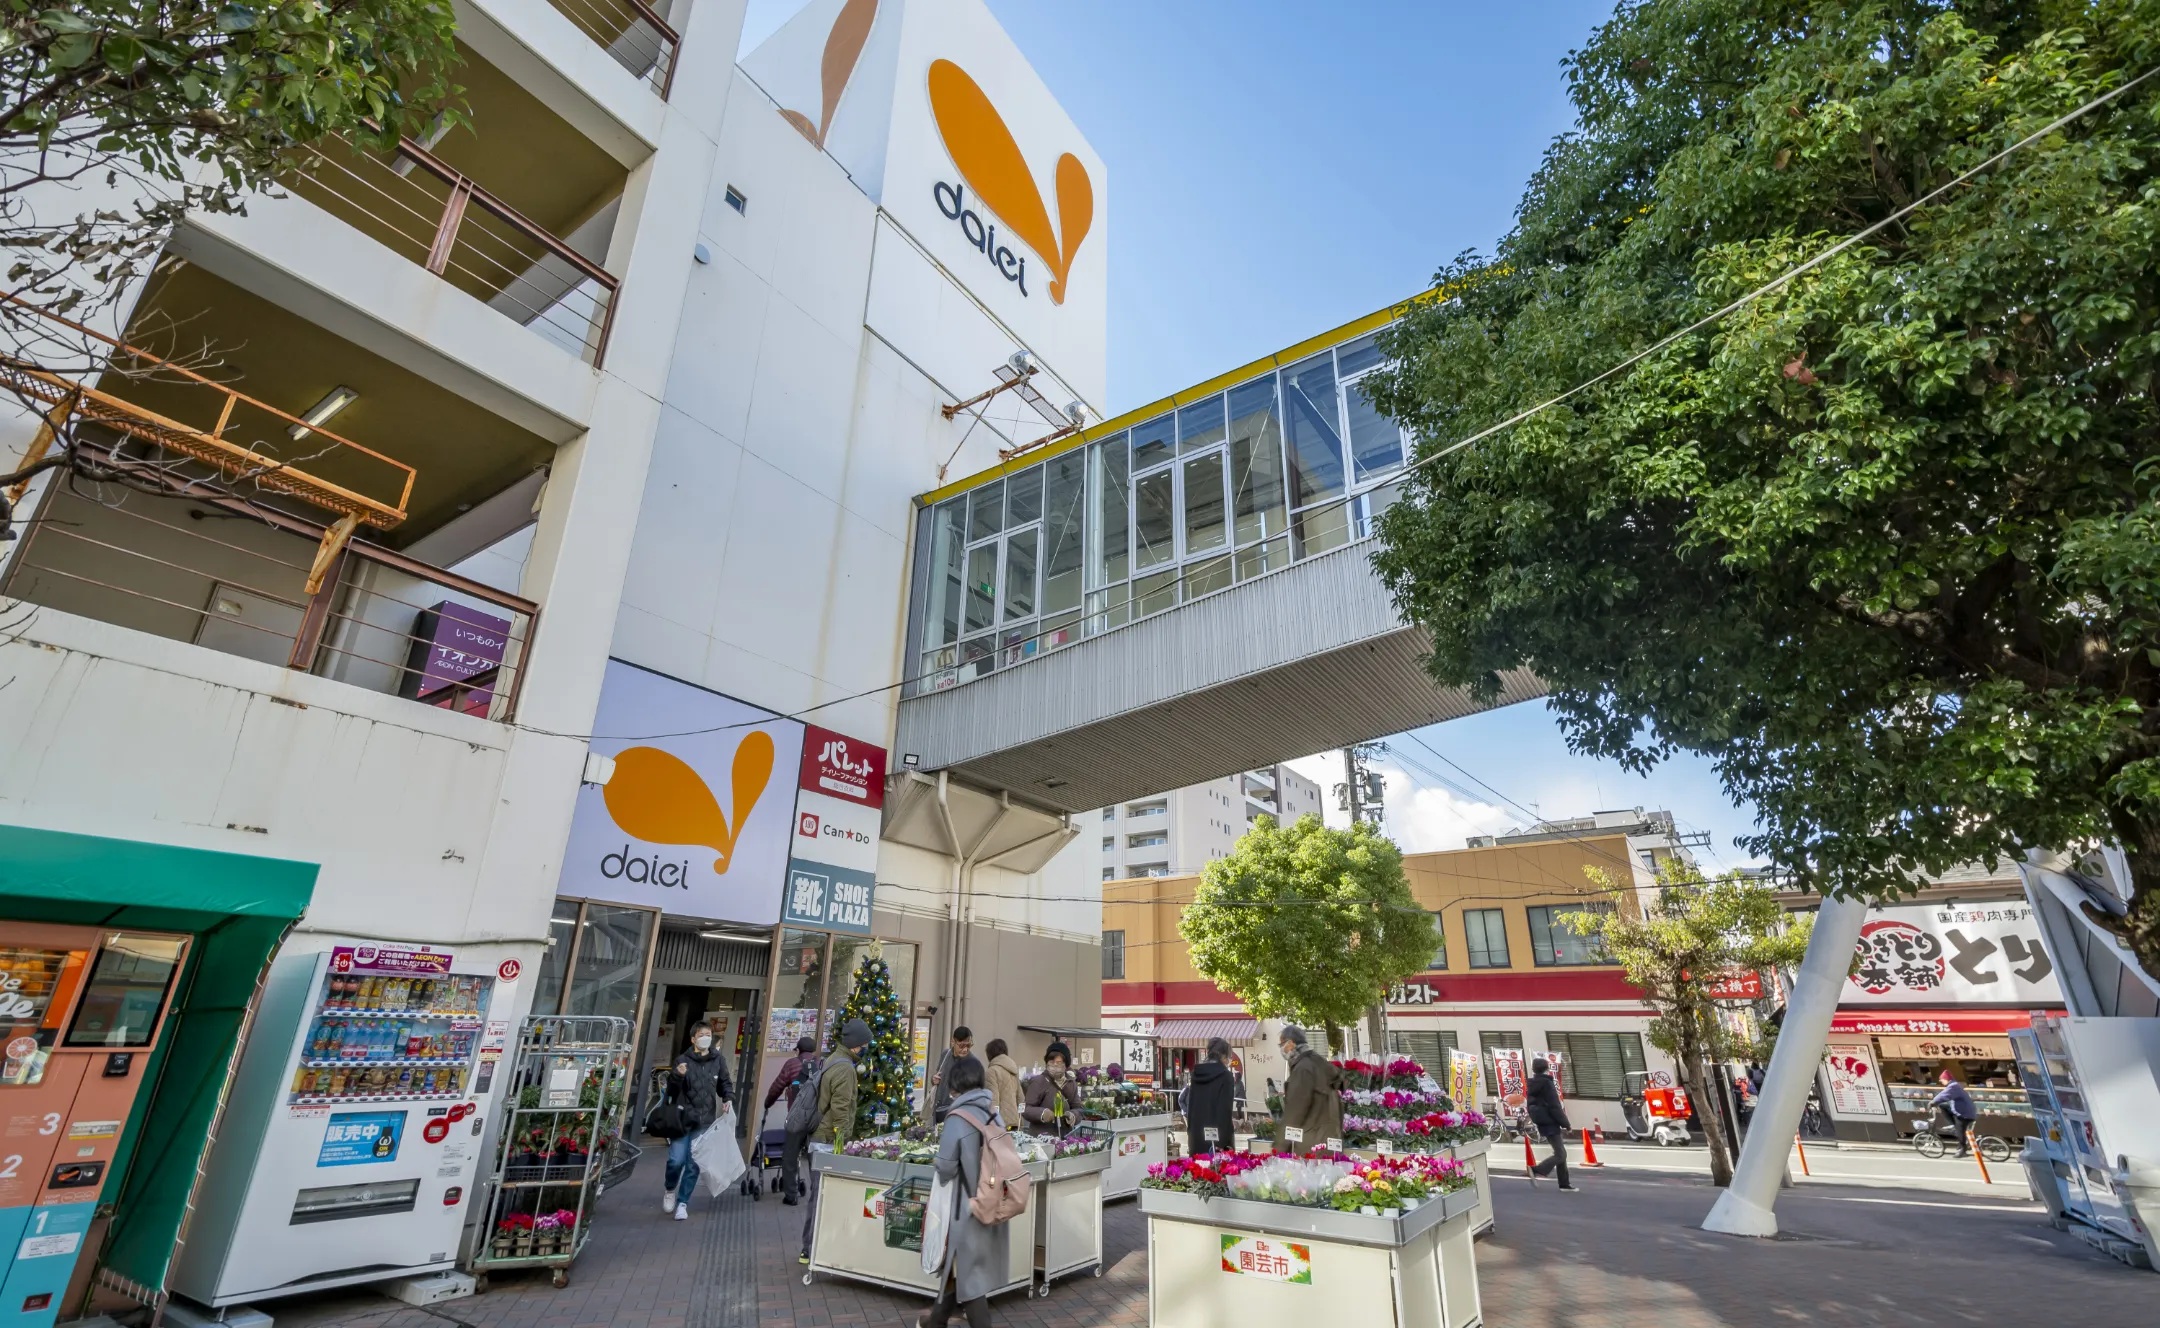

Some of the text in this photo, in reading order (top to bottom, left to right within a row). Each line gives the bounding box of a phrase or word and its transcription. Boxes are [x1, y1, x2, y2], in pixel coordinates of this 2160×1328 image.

[933, 182, 1028, 298] daiei
[818, 740, 873, 777] パレット
[601, 843, 689, 890] daiei
[793, 876, 823, 917] 靴
[834, 880, 870, 906] SHOE
[829, 901, 870, 927] PLAZA
[39, 1112, 61, 1136] 3
[325, 1124, 380, 1142] 販売中
[0, 1154, 23, 1178] 2
[36, 1211, 49, 1234] 1
[1240, 1251, 1289, 1276] 園芸市
